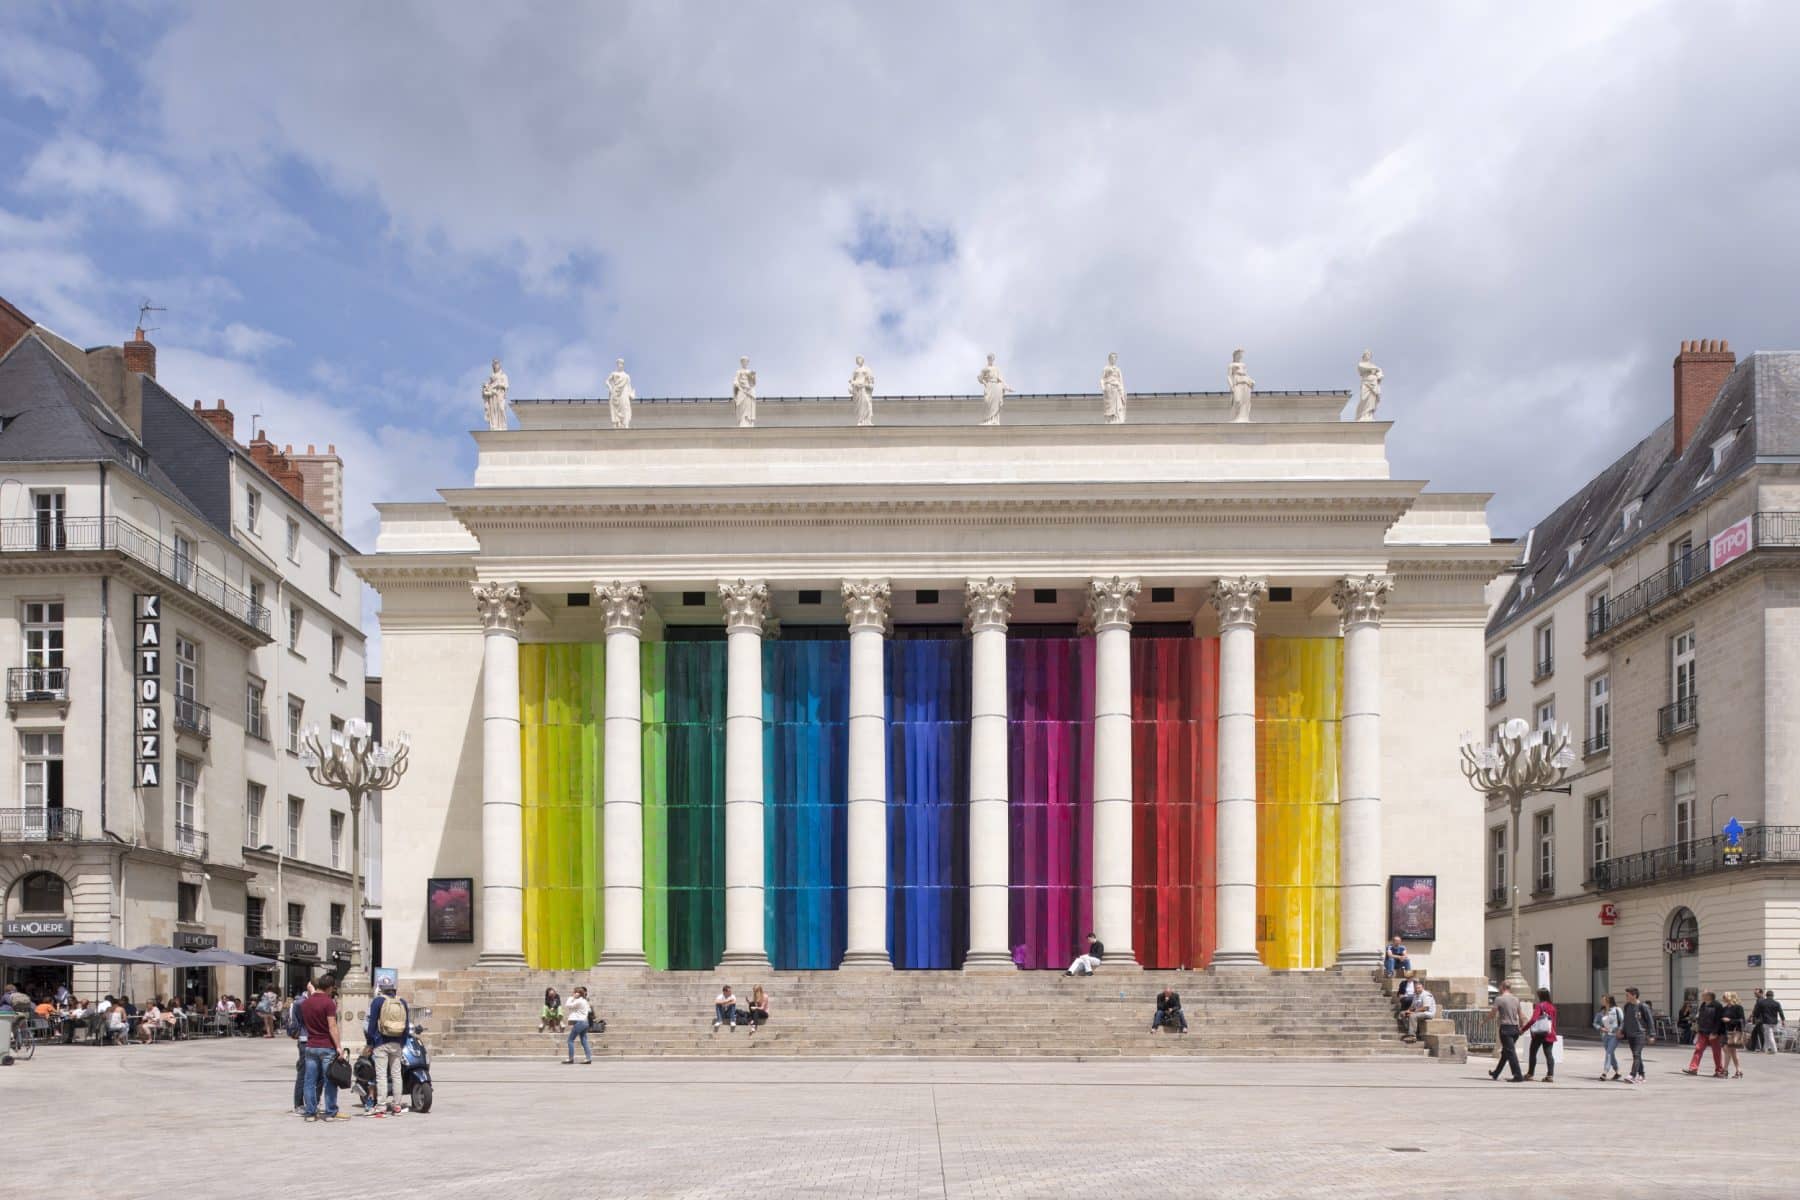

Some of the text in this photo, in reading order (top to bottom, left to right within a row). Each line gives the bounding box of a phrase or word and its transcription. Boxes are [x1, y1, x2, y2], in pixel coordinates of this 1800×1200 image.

[1715, 530, 1746, 559] ETPO
[142, 595, 158, 785] KATORZA
[8, 923, 19, 933] LE
[1664, 938, 1689, 954] Quick
